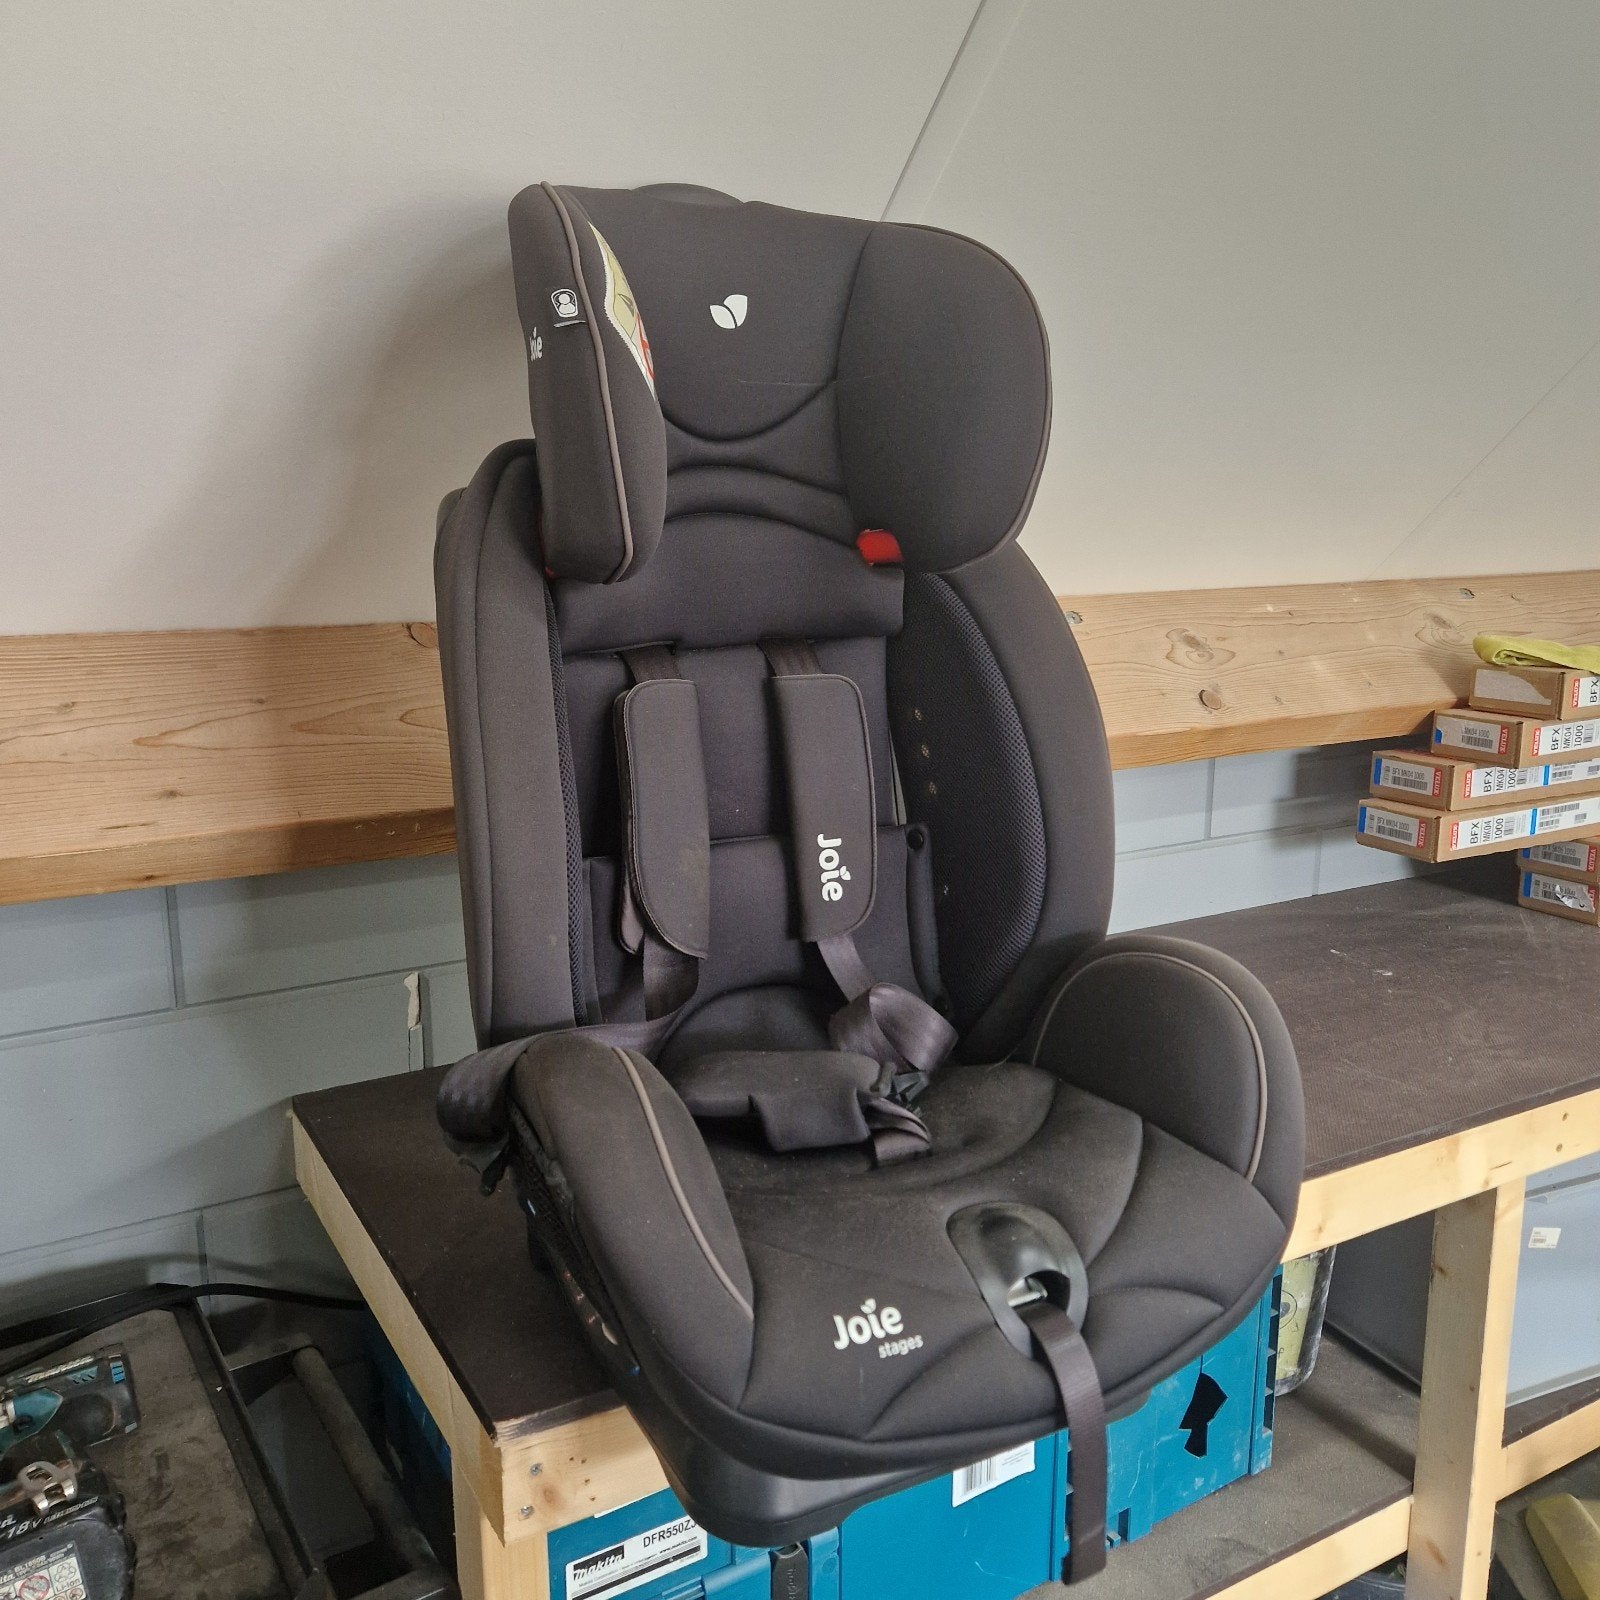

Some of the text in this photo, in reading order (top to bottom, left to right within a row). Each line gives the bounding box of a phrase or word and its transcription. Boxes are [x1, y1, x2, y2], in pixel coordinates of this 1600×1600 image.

[1572, 680, 1580, 708] VELUX
[1590, 679, 1600, 703] BFX
[1500, 728, 1508, 753] VELUX
[1532, 729, 1541, 756] VELUX
[1551, 728, 1561, 751] BFX
[1563, 726, 1572, 749] MK04
[1574, 724, 1584, 747] 1000
[1433, 771, 1442, 797] VELUX
[1464, 771, 1472, 799] VELUX
[1483, 770, 1493, 793] BFX
[1496, 769, 1505, 791] MK04
[1507, 768, 1518, 789] 1000
[1418, 823, 1427, 849] VELUX
[1451, 823, 1459, 851] VELUX
[1470, 821, 1480, 844] BFX
[1482, 820, 1492, 843] MK04
[1494, 818, 1504, 840] 1000
[817, 833, 851, 902] Joie
[1588, 848, 1597, 872] VELUX
[832, 1297, 905, 1350] Joie
[877, 1334, 925, 1359] stages
